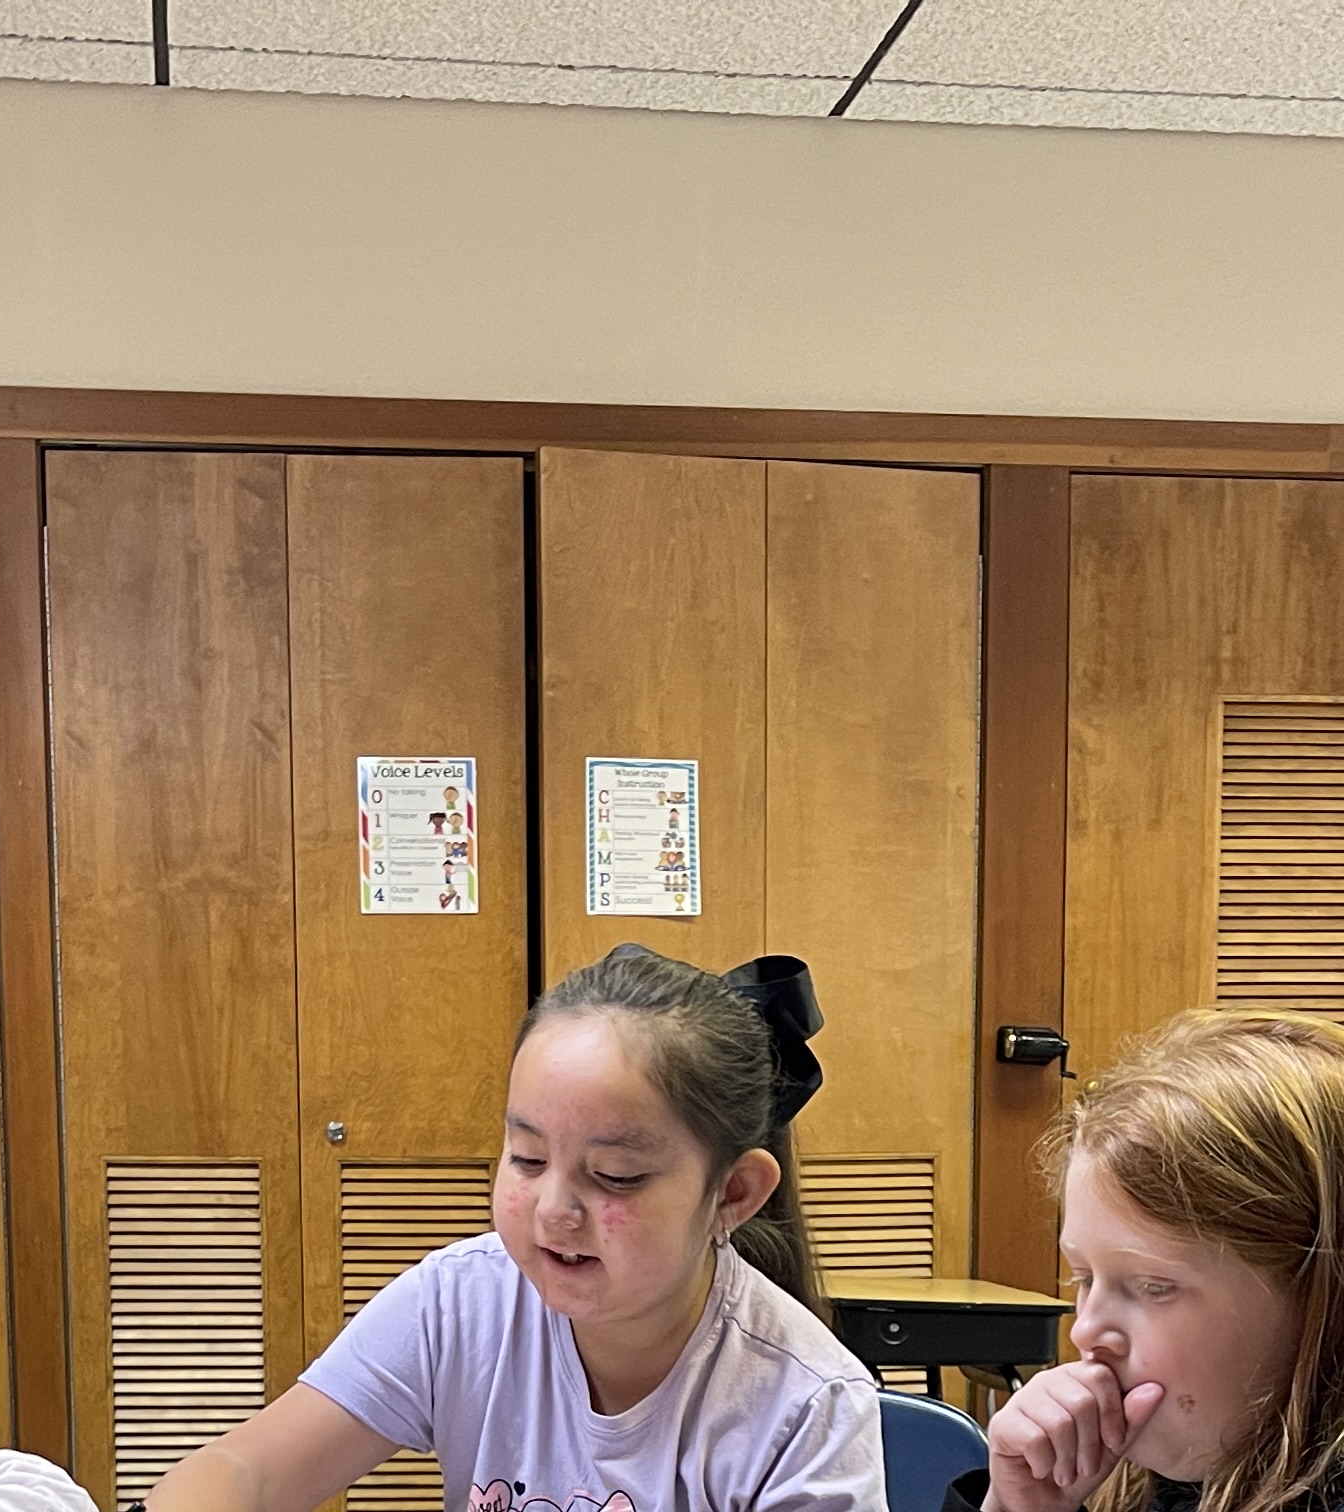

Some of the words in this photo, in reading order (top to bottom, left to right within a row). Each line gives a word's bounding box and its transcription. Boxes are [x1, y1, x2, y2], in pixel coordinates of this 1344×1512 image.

[371, 766, 411, 778] Voice
[414, 765, 464, 778] Levels
[642, 769, 669, 779] Group
[372, 789, 383, 804] 0
[598, 789, 610, 804] C
[374, 813, 382, 828] 1
[598, 808, 611, 823] H
[598, 828, 611, 843] A
[372, 836, 384, 851] 2
[597, 851, 613, 865] M
[374, 861, 385, 875] 3
[599, 872, 612, 887] P
[374, 887, 385, 902] 4
[600, 892, 611, 907] S
